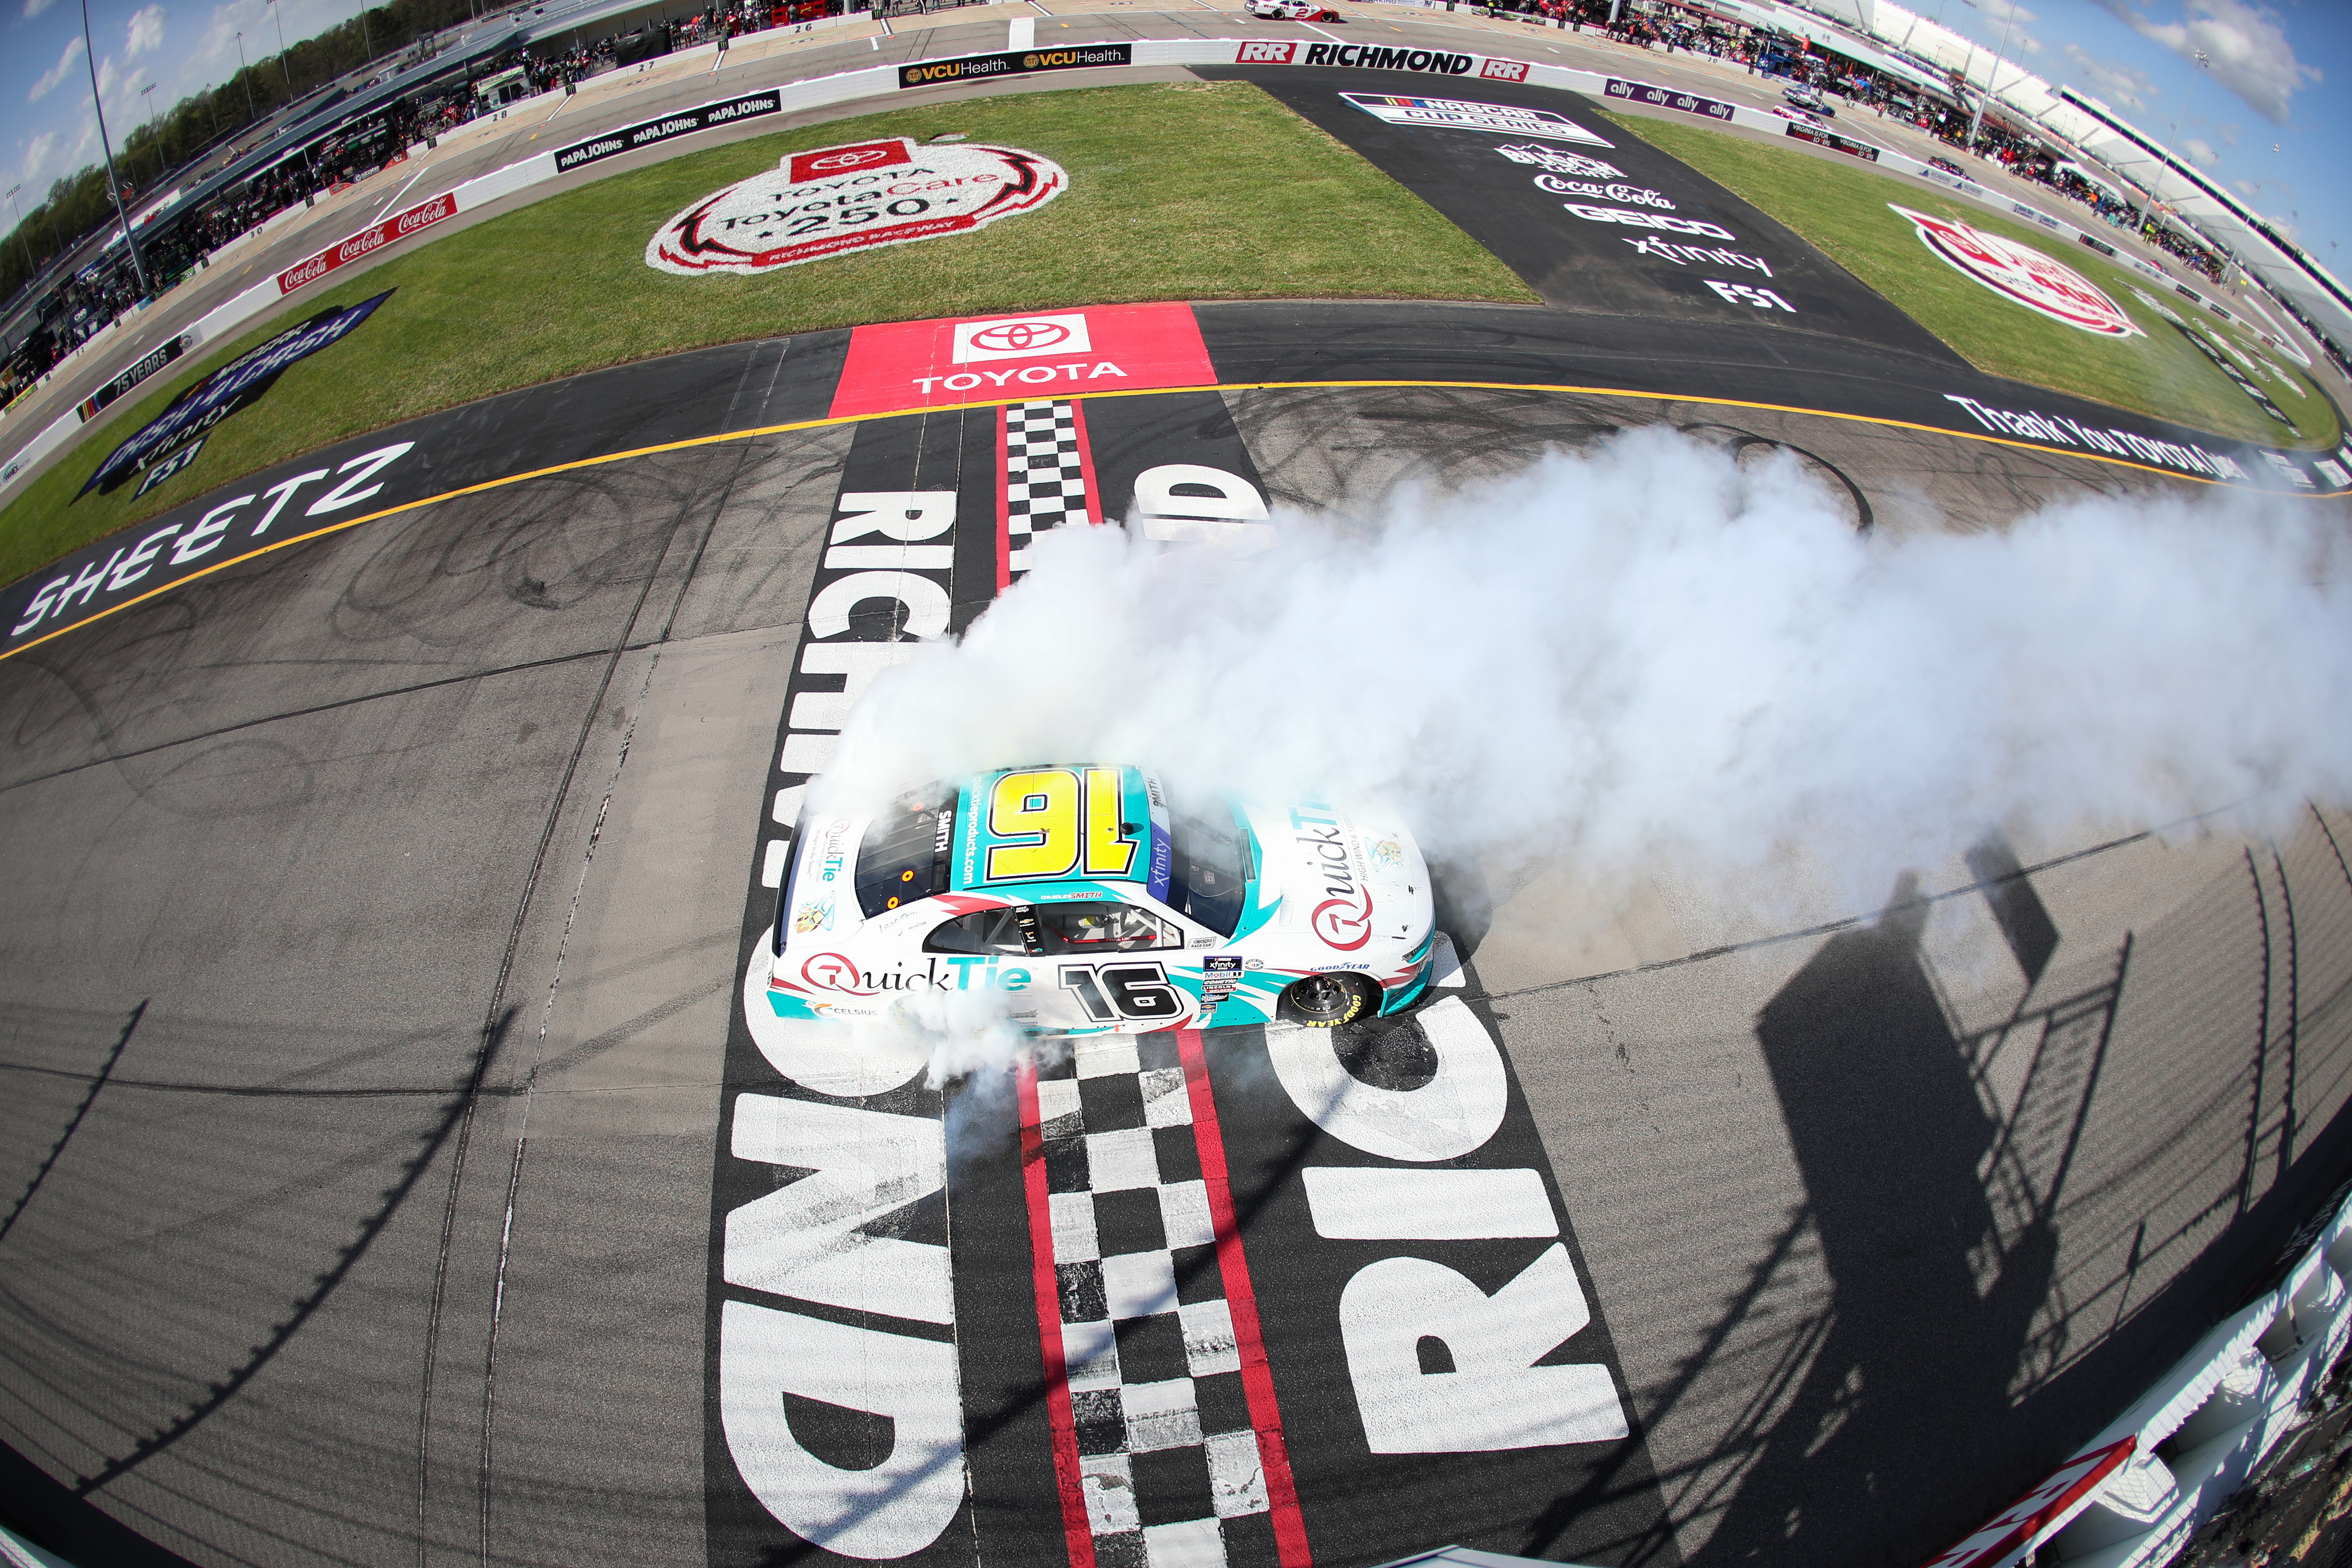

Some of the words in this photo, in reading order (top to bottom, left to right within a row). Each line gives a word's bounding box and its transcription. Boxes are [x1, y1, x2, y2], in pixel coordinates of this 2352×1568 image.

[1294, 8, 1309, 17] 2
[795, 23, 812, 34] 26
[1039, 52, 1076, 66] VCU
[1078, 49, 1121, 64] Health
[1241, 43, 1290, 61] RR
[1305, 43, 1473, 75] RICHMOND
[639, 61, 655, 72] 27
[922, 64, 960, 80] VCU
[961, 59, 1007, 76] Health
[1486, 61, 1526, 80] RR
[1610, 82, 1634, 99] ally
[1647, 89, 1670, 105] ally
[1677, 95, 1699, 112] ally
[492, 110, 508, 123] 28
[708, 105, 736, 123] PAPA
[736, 99, 775, 117] JOHNS
[1405, 110, 1466, 123] CUP
[1469, 117, 1570, 134] SERIES
[1421, 100, 1541, 120] NASCAR
[1709, 104, 1730, 119] ally
[1816, 104, 1824, 112] 21
[634, 125, 662, 144] PAPA
[661, 118, 697, 137] JOHNS
[1793, 124, 1814, 135] VIRGINIA
[560, 146, 588, 167] PAPA
[586, 139, 623, 159] JOHNS
[1840, 138, 1859, 149] VIRGINIA
[1863, 146, 1873, 154] FOR
[1494, 147, 1628, 178] BUSCH
[1543, 165, 1612, 180] LIGHT
[768, 168, 935, 202] TOYOTA
[1534, 174, 1676, 210] Coca-Cola
[398, 196, 447, 233] Coca-Cola
[785, 198, 930, 237] 250
[1564, 203, 1736, 241] GEICO
[250, 227, 263, 239] 30
[340, 225, 384, 261] Coca-Cola
[769, 231, 866, 262] RICHMOND
[868, 219, 956, 241] RACEWAY
[285, 253, 327, 289] Coca-Cola
[1622, 236, 1773, 278] xfinity
[1703, 280, 1797, 313] FS1
[114, 373, 130, 397] 75
[129, 348, 168, 384] YEARS
[912, 361, 1128, 394] TOYOTA
[1943, 394, 2078, 445] Thank
[2053, 416, 2129, 456] You
[138, 439, 203, 496] FS1
[10, 440, 417, 637] SHEETZ
[1146, 777, 1164, 808] SMITH
[934, 810, 952, 853] SMITH
[963, 776, 984, 885] quicktieproducts.com
[983, 766, 1141, 884] 16
[822, 818, 851, 882] QuickTie
[1149, 837, 1171, 888] xfinity
[1351, 840, 1363, 862] WIND
[1357, 862, 1369, 882] HIGH
[1070, 891, 1103, 899] SMITH
[801, 952, 1032, 997] QuickTie
[1310, 962, 1370, 972] GOODYEAR
[1057, 961, 1184, 1022] 16
[834, 1008, 878, 1017] CELSIUS
[1306, 994, 1362, 1028] GOODYEAR
